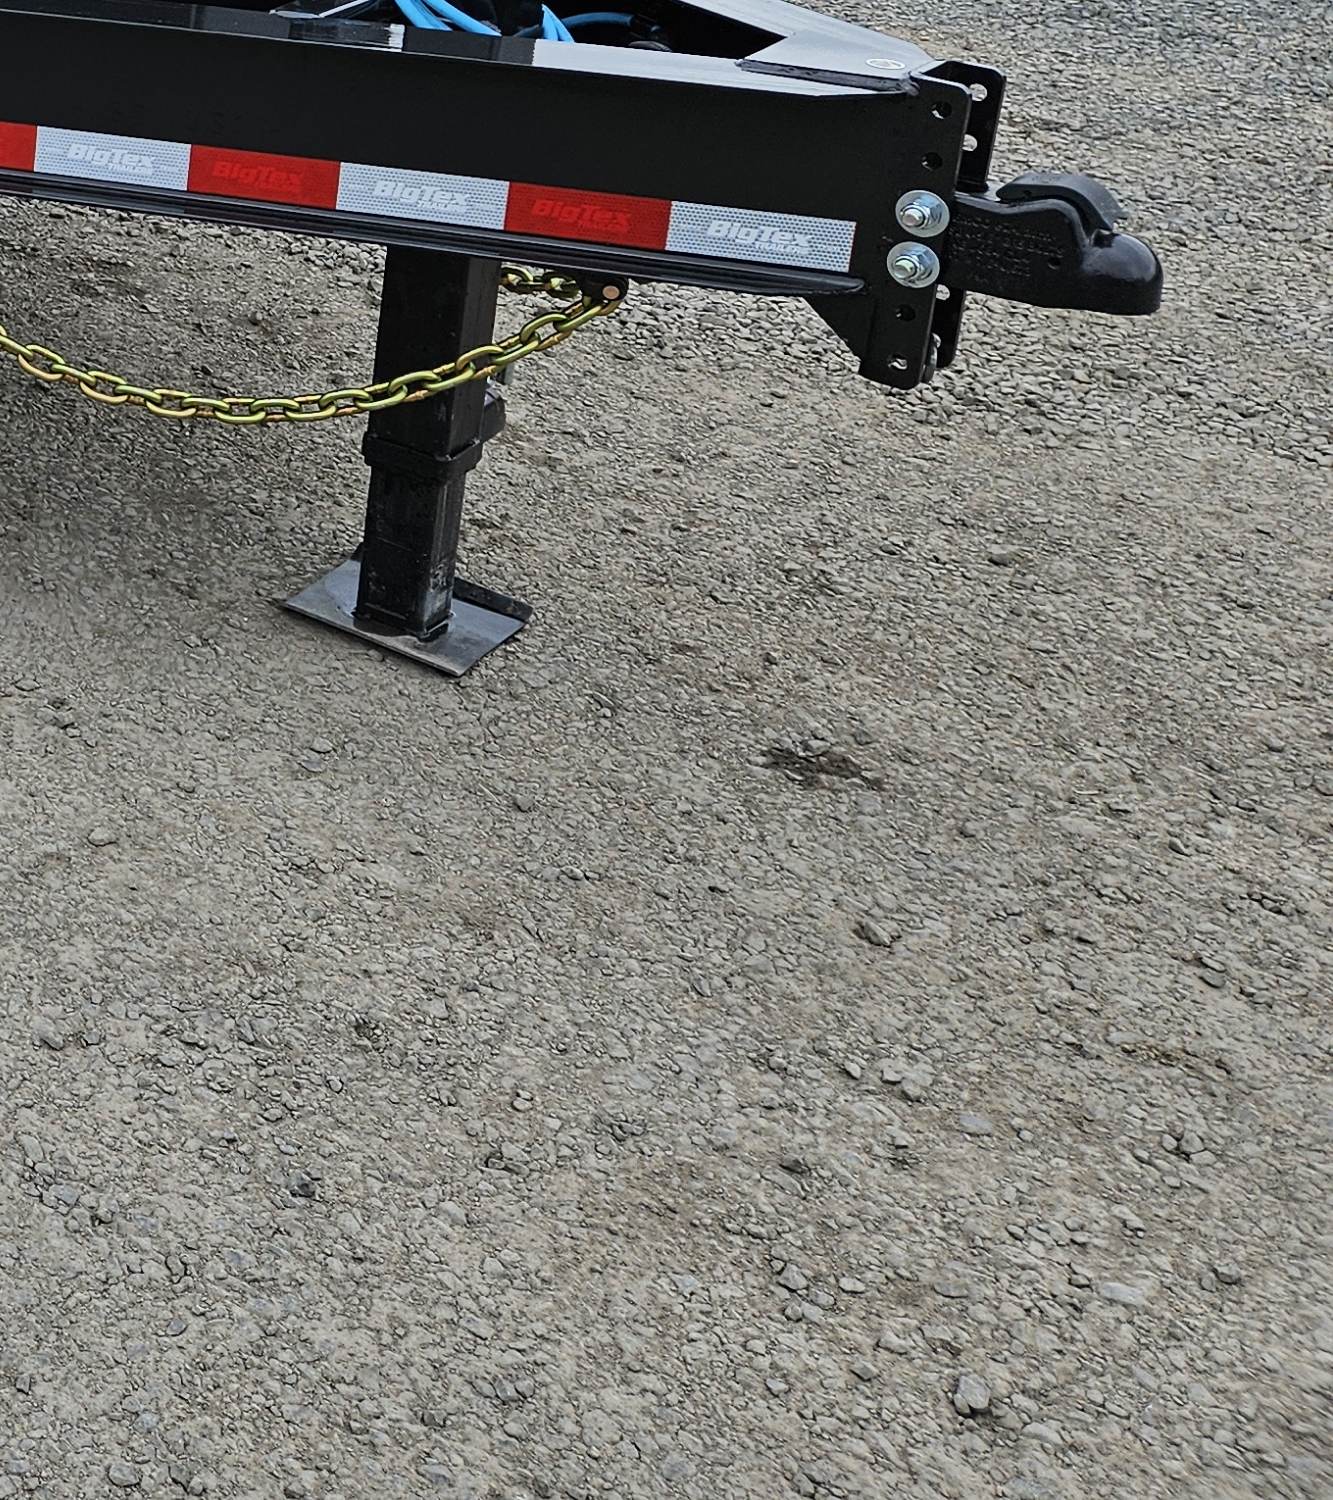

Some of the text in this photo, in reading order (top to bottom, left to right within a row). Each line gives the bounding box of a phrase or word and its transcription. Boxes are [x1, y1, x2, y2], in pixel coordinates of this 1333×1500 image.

[67, 144, 156, 167] BigTex
[212, 161, 303, 185] BigTex
[372, 181, 470, 205] BigTex
[533, 200, 632, 227] BigTex
[707, 220, 814, 246] BigTex
